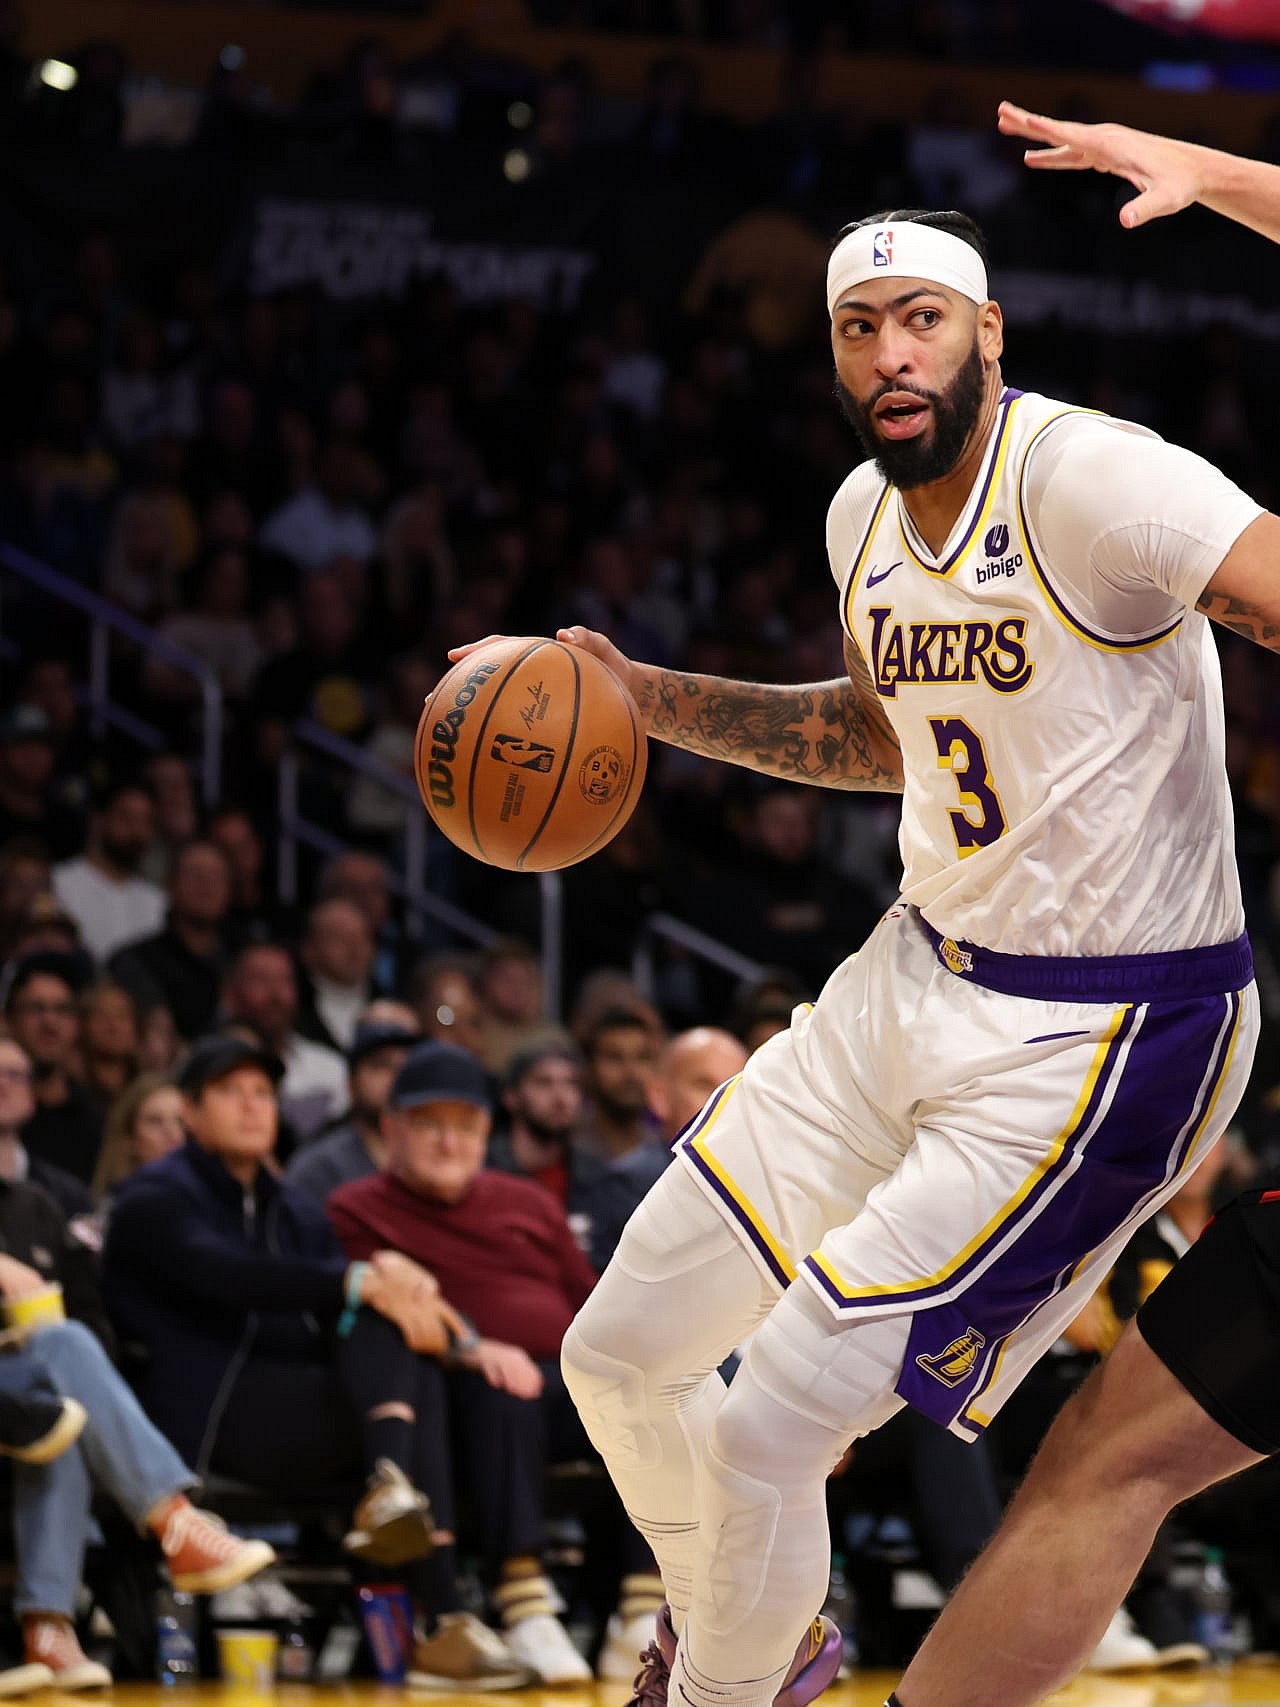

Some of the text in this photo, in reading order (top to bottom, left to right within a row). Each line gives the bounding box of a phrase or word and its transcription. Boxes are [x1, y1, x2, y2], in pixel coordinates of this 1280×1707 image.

[976, 553, 1023, 584] bibigo
[867, 604, 1036, 700] LAKERS
[428, 662, 501, 809] Wilson
[924, 715, 1010, 860] 3
